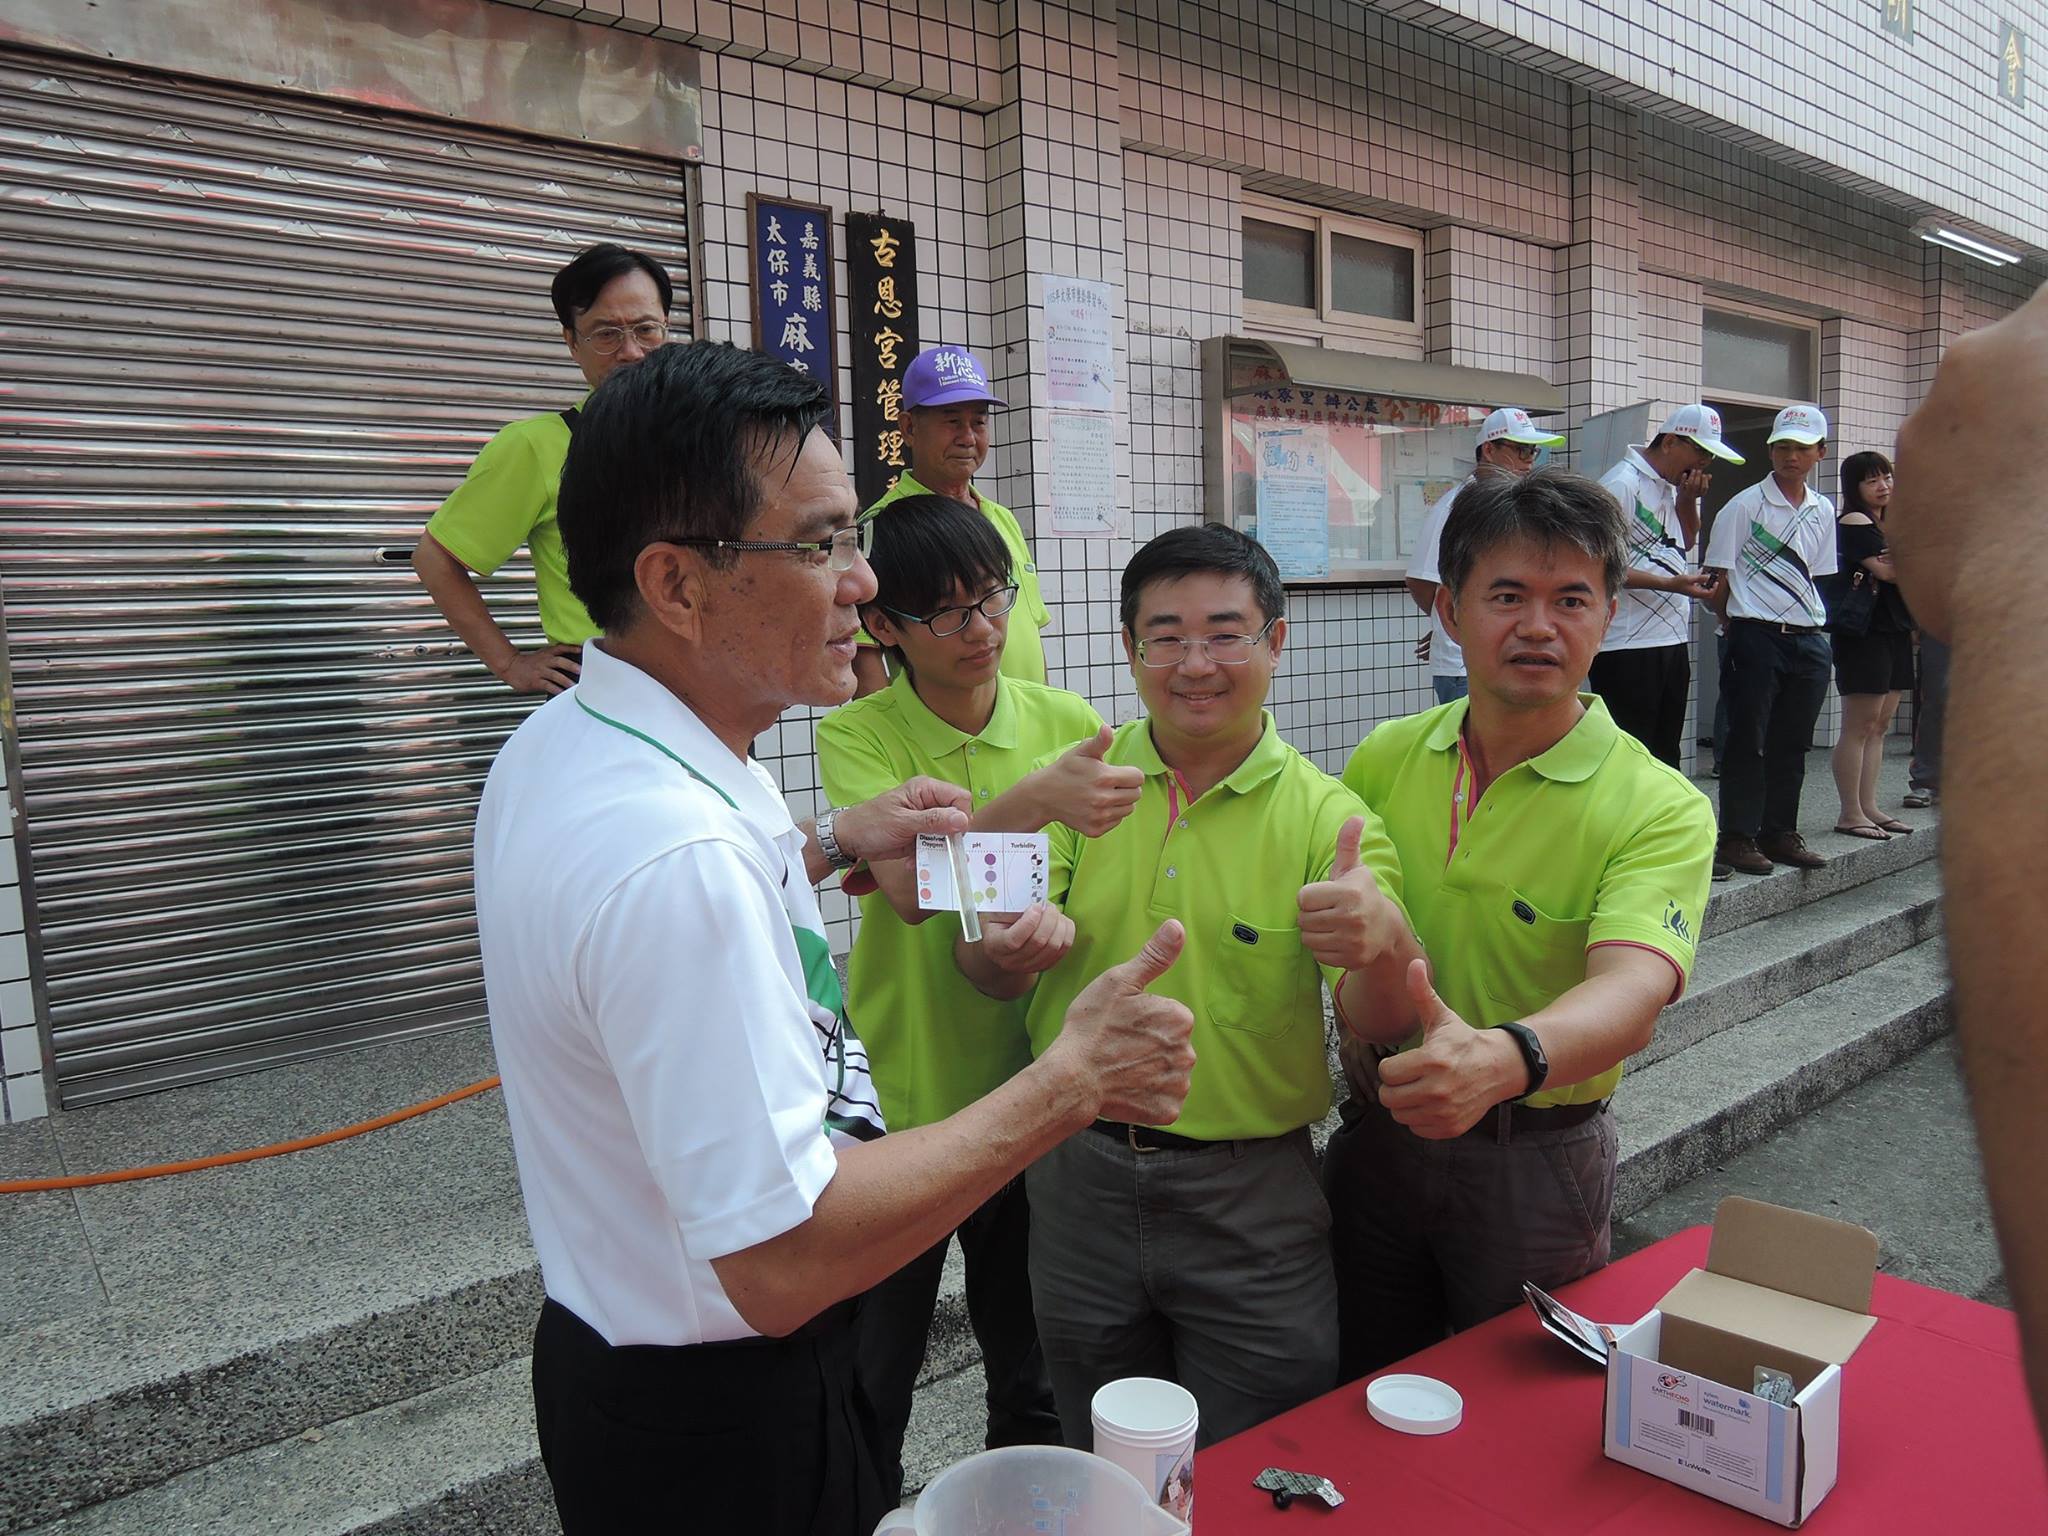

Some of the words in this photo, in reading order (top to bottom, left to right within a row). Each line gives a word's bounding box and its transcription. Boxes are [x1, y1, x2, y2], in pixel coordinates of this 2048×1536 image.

[766, 216, 789, 307] 太保市
[800, 222, 822, 312] 嘉義縣
[919, 834, 946, 842] Dissolved
[921, 841, 943, 849] Oxygen
[1011, 842, 1037, 850] Turbidity
[1703, 1397, 1751, 1418] watermark
